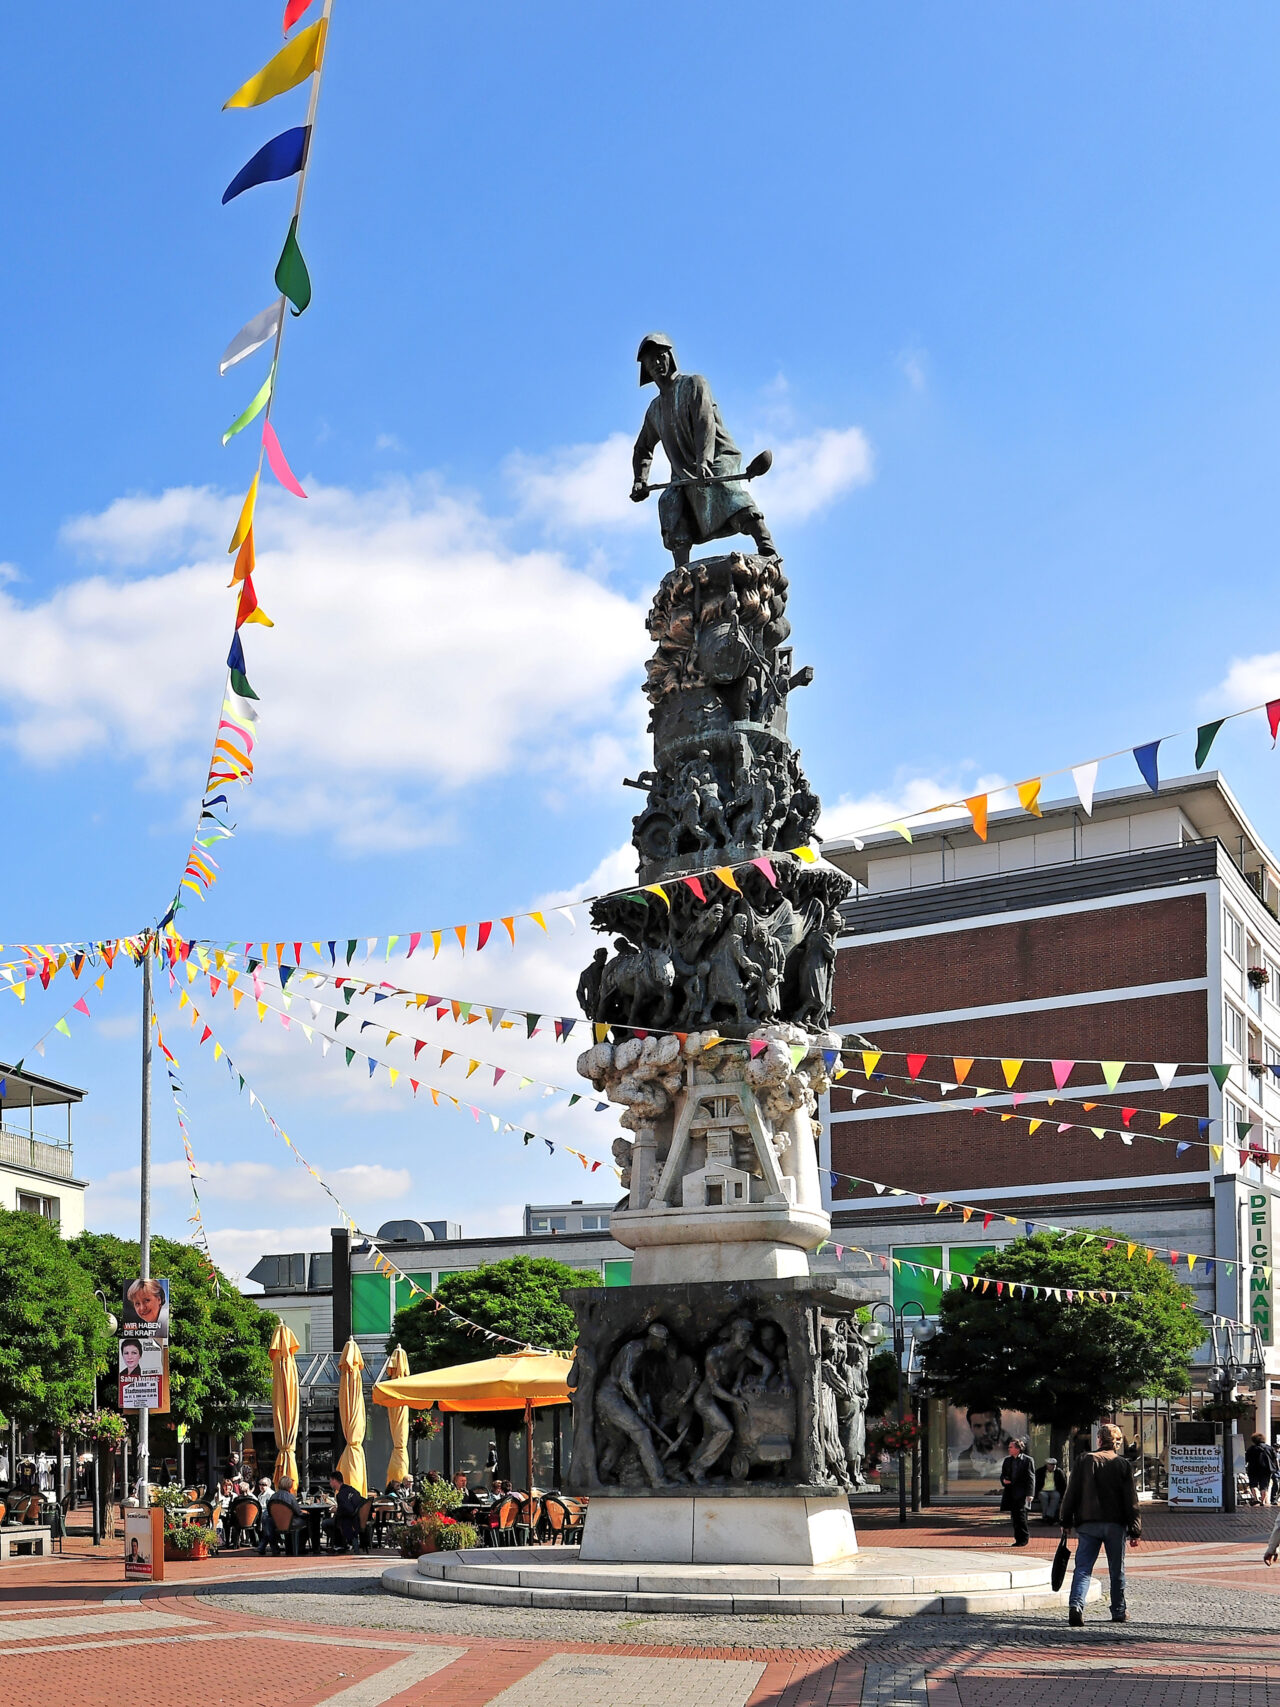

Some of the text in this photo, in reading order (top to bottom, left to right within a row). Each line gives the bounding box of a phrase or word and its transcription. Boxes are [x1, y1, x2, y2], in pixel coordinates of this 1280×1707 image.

[1250, 1195, 1270, 1341] DEICHMANN
[1170, 1464, 1220, 1475] Tagesangebot
[1170, 1477, 1189, 1485] Mett
